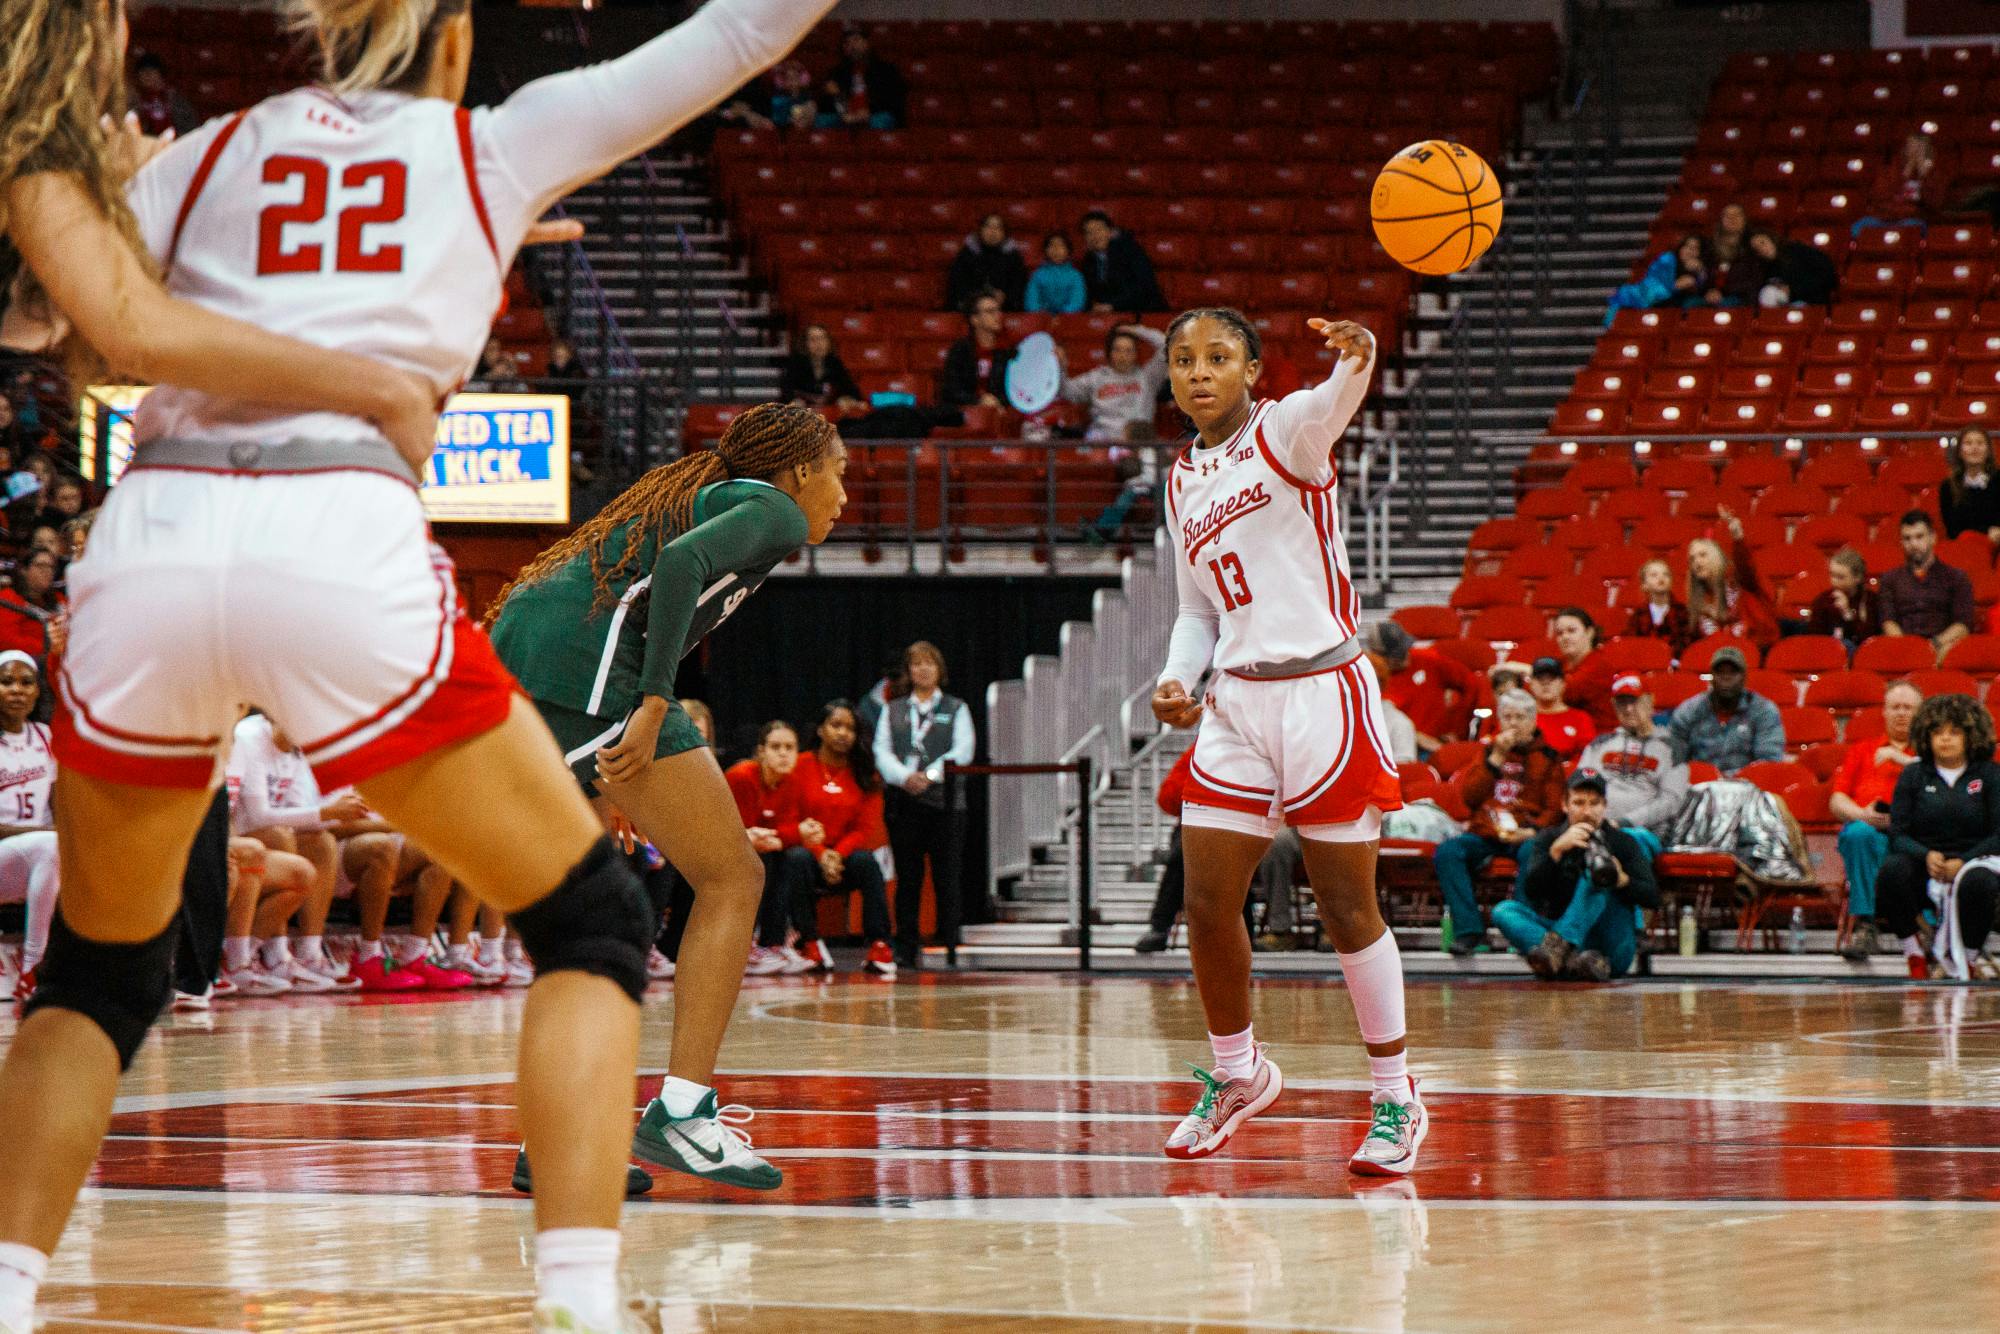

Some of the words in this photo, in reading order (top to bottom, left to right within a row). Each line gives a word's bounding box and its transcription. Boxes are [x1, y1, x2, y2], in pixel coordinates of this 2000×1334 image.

[256, 154, 407, 277] 22
[494, 411, 551, 445] TEA
[444, 448, 532, 486] KICK.
[1183, 481, 1268, 552] Badgers
[1208, 551, 1253, 613] 13
[16, 792, 34, 819] 15
